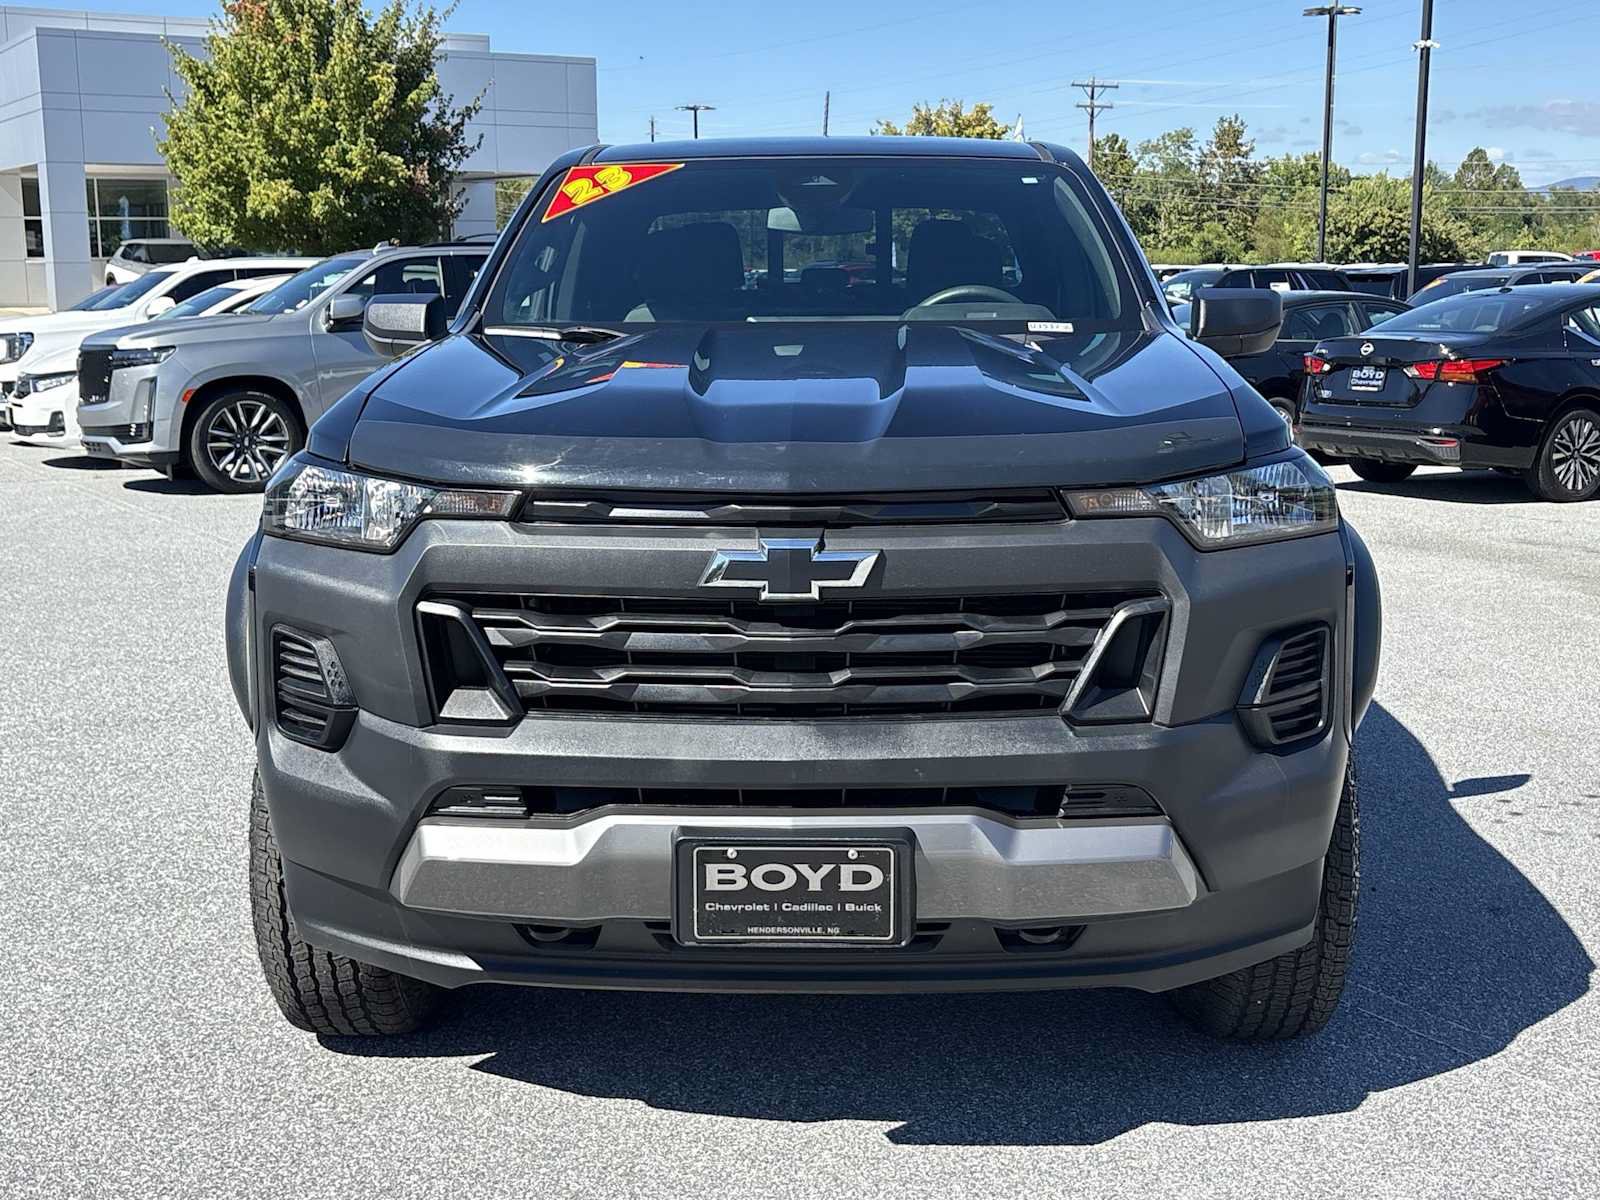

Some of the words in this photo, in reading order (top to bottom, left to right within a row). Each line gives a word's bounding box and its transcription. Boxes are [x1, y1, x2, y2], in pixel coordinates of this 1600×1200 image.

[562, 165, 632, 205] 23
[1352, 369, 1384, 379] BOYD
[704, 863, 883, 891] BOYD
[705, 902, 770, 912] Chevrolet
[781, 902, 833, 912] Cadillac
[845, 902, 882, 912] Buick
[747, 926, 826, 935] HENDERSONVILLE,
